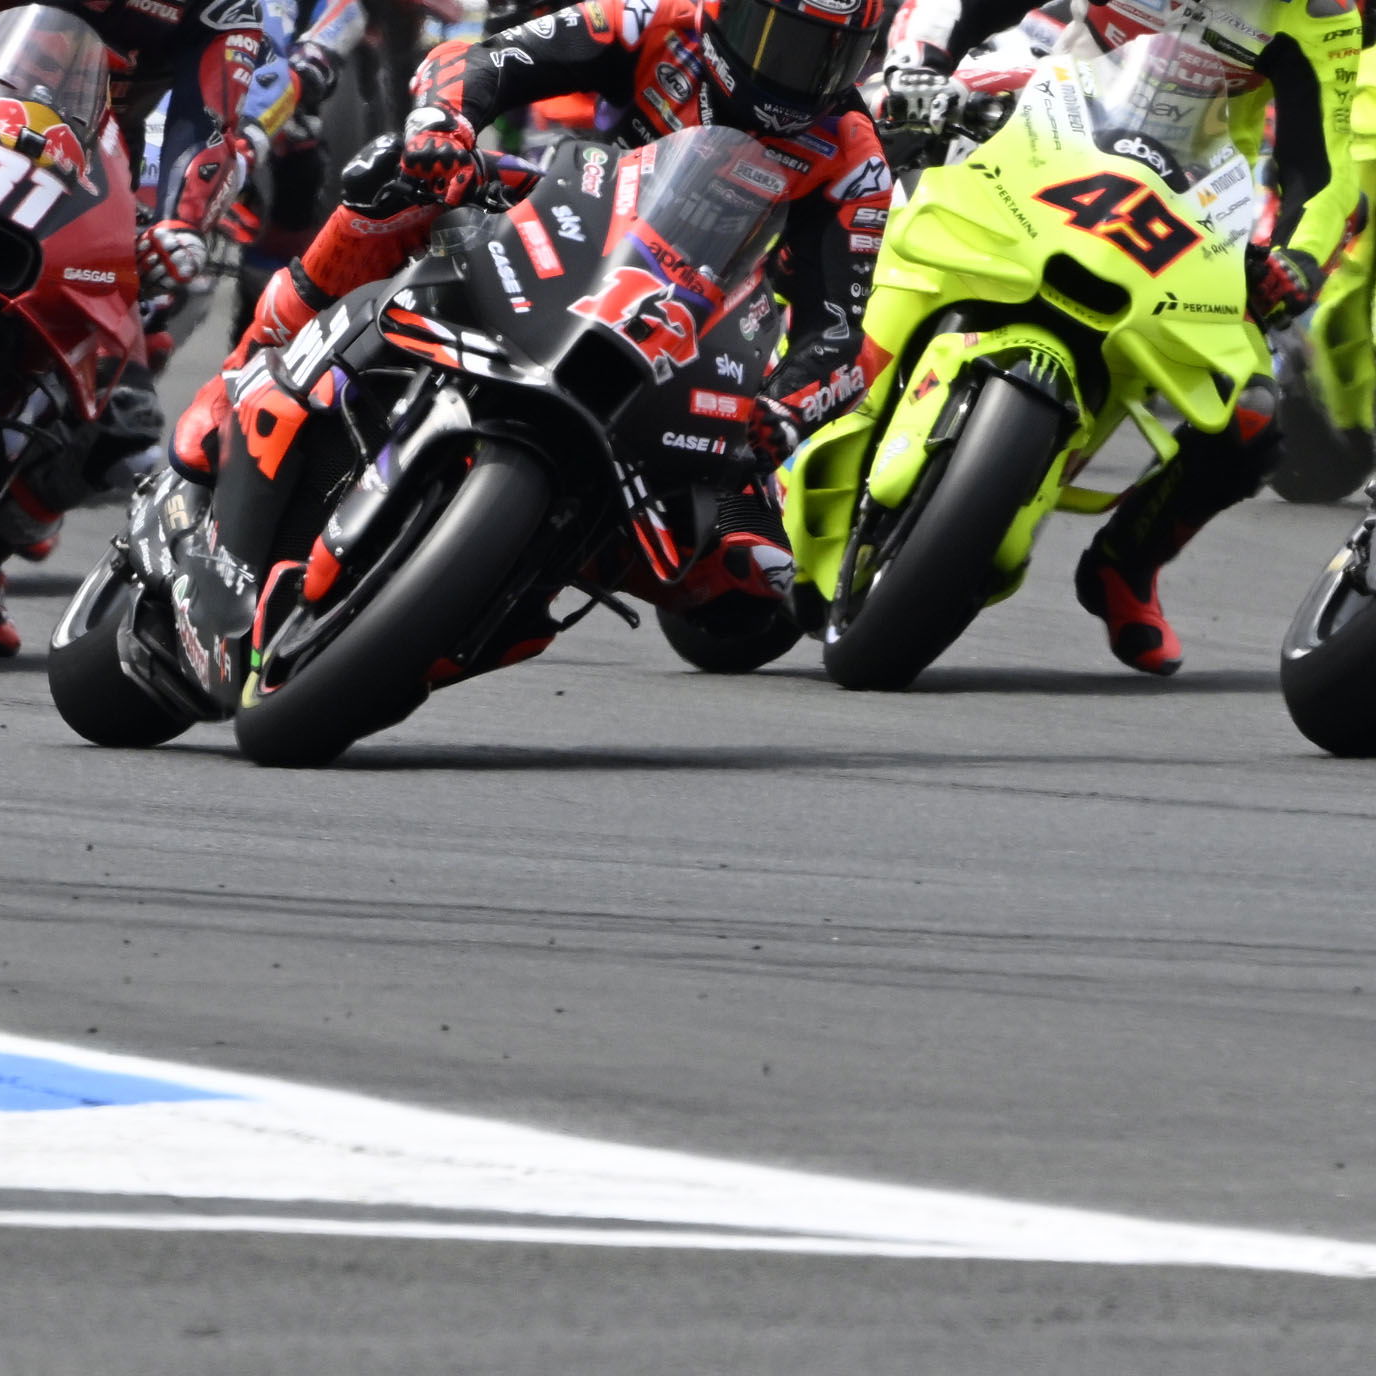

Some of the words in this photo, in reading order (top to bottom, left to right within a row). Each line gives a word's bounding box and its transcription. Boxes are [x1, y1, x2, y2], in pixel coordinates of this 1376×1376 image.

[1113, 136, 1174, 178] ebay
[994, 184, 1040, 240] PERTAMINA
[1030, 170, 1206, 279] 49
[63, 266, 117, 285] GASGAS
[667, 241, 727, 295] aprilia
[1182, 302, 1240, 317] PERTAMINA
[714, 353, 744, 385] sky
[799, 363, 866, 422] aprilia
[661, 431, 709, 451] CASE
